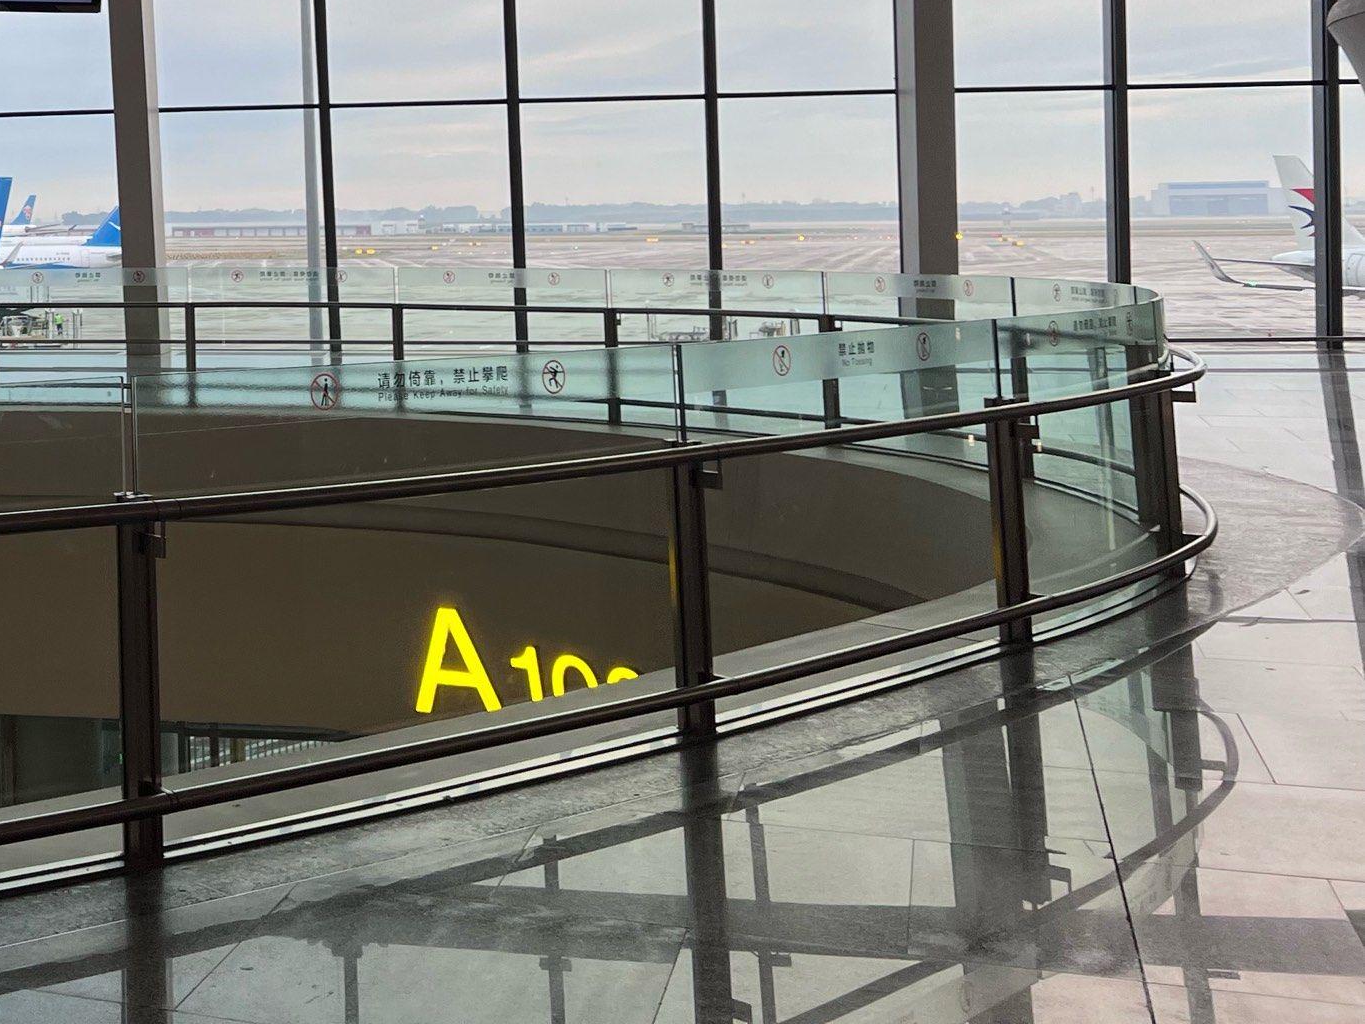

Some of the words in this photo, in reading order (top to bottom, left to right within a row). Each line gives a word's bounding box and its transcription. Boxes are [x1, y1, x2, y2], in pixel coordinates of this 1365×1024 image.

[378, 392, 409, 402] Please
[413, 391, 435, 401] Keep
[439, 389, 462, 398] Away
[482, 385, 508, 396] Safety
[415, 607, 639, 714] A10
